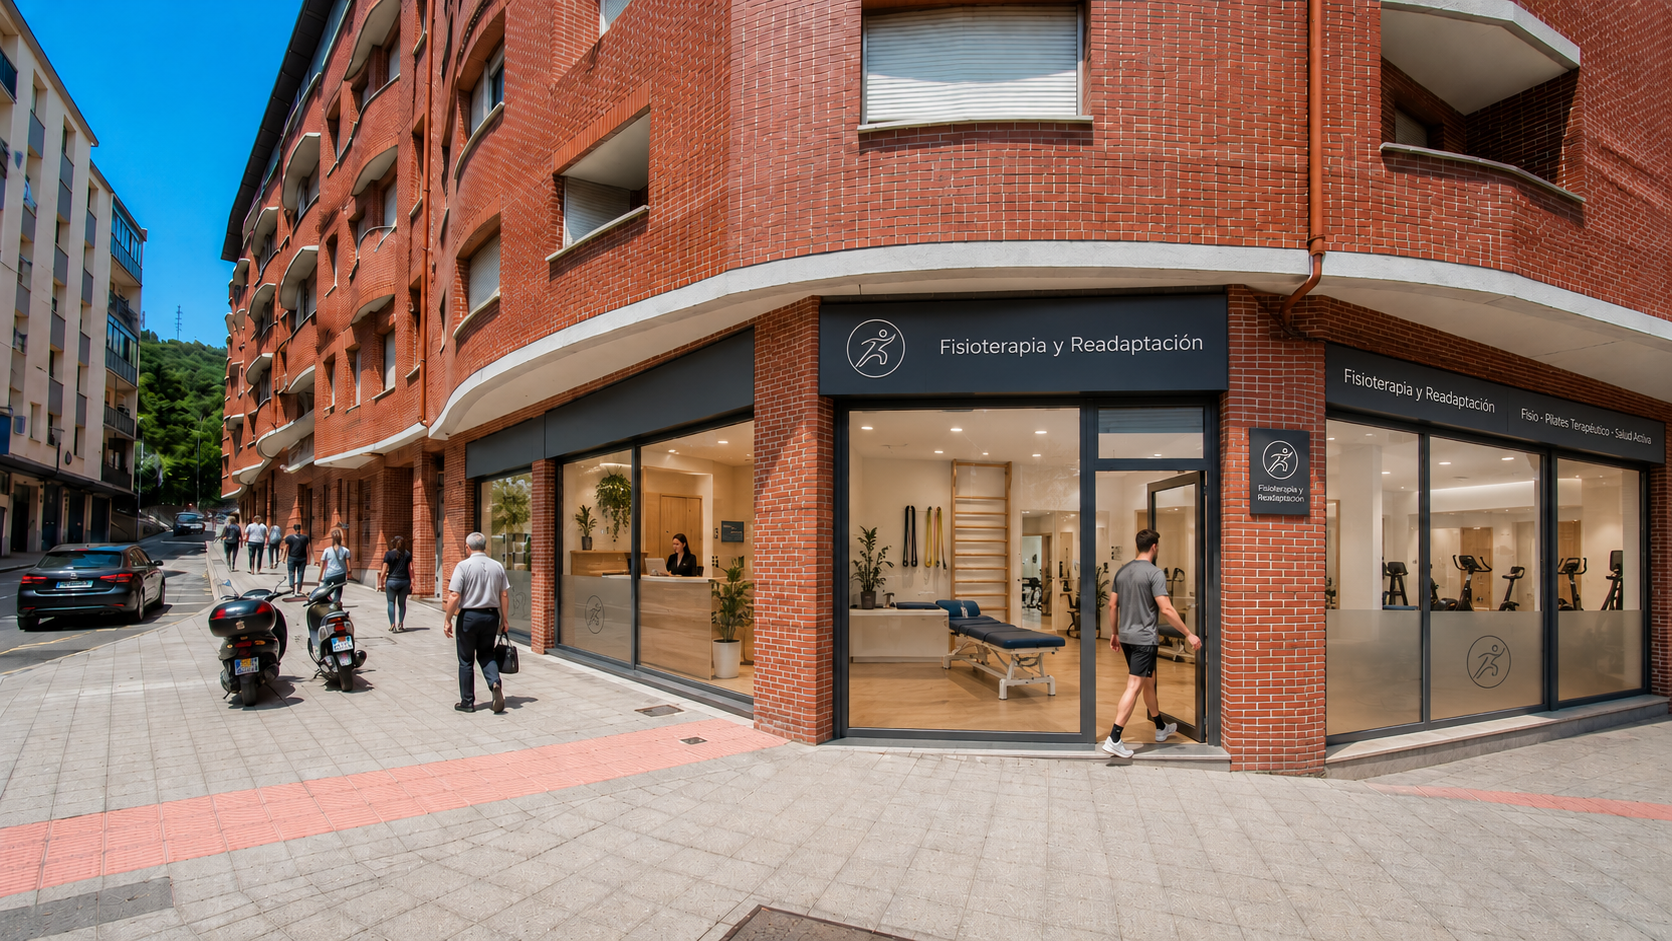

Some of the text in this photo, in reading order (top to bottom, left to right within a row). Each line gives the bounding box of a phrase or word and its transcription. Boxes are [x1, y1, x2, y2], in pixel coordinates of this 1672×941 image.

[940, 333, 1203, 358] Fisioterapia y Readaptación
[1344, 368, 1495, 413] Fisioterapia y Readaptación
[1521, 408, 1539, 423] Fisio
[1545, 412, 1569, 428] Pilates
